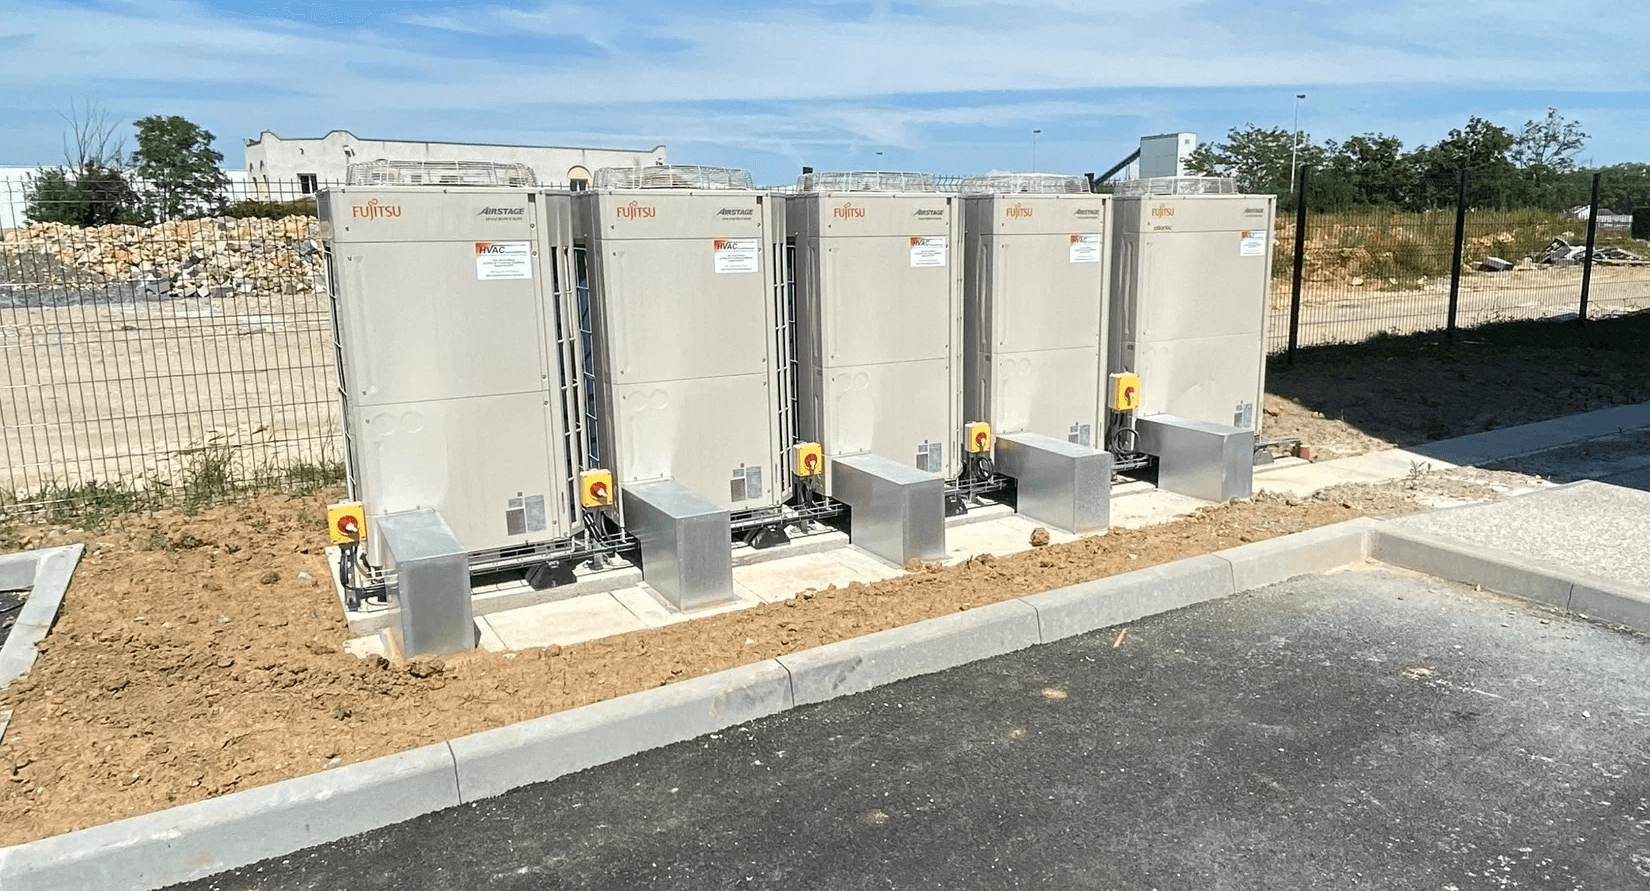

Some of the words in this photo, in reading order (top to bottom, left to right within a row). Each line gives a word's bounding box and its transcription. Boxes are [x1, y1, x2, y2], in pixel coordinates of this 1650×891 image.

[352, 198, 401, 221] FUJITSU
[477, 206, 525, 216] AIRSTAGE
[616, 200, 656, 221] FUJITSU
[716, 208, 753, 216] AIRSTAGE
[833, 202, 865, 220] FUJITSU
[1006, 202, 1033, 219] FUJITSU
[1151, 203, 1175, 219] FUJITSU
[479, 244, 506, 255] HVAC
[716, 241, 738, 250] HVAC
